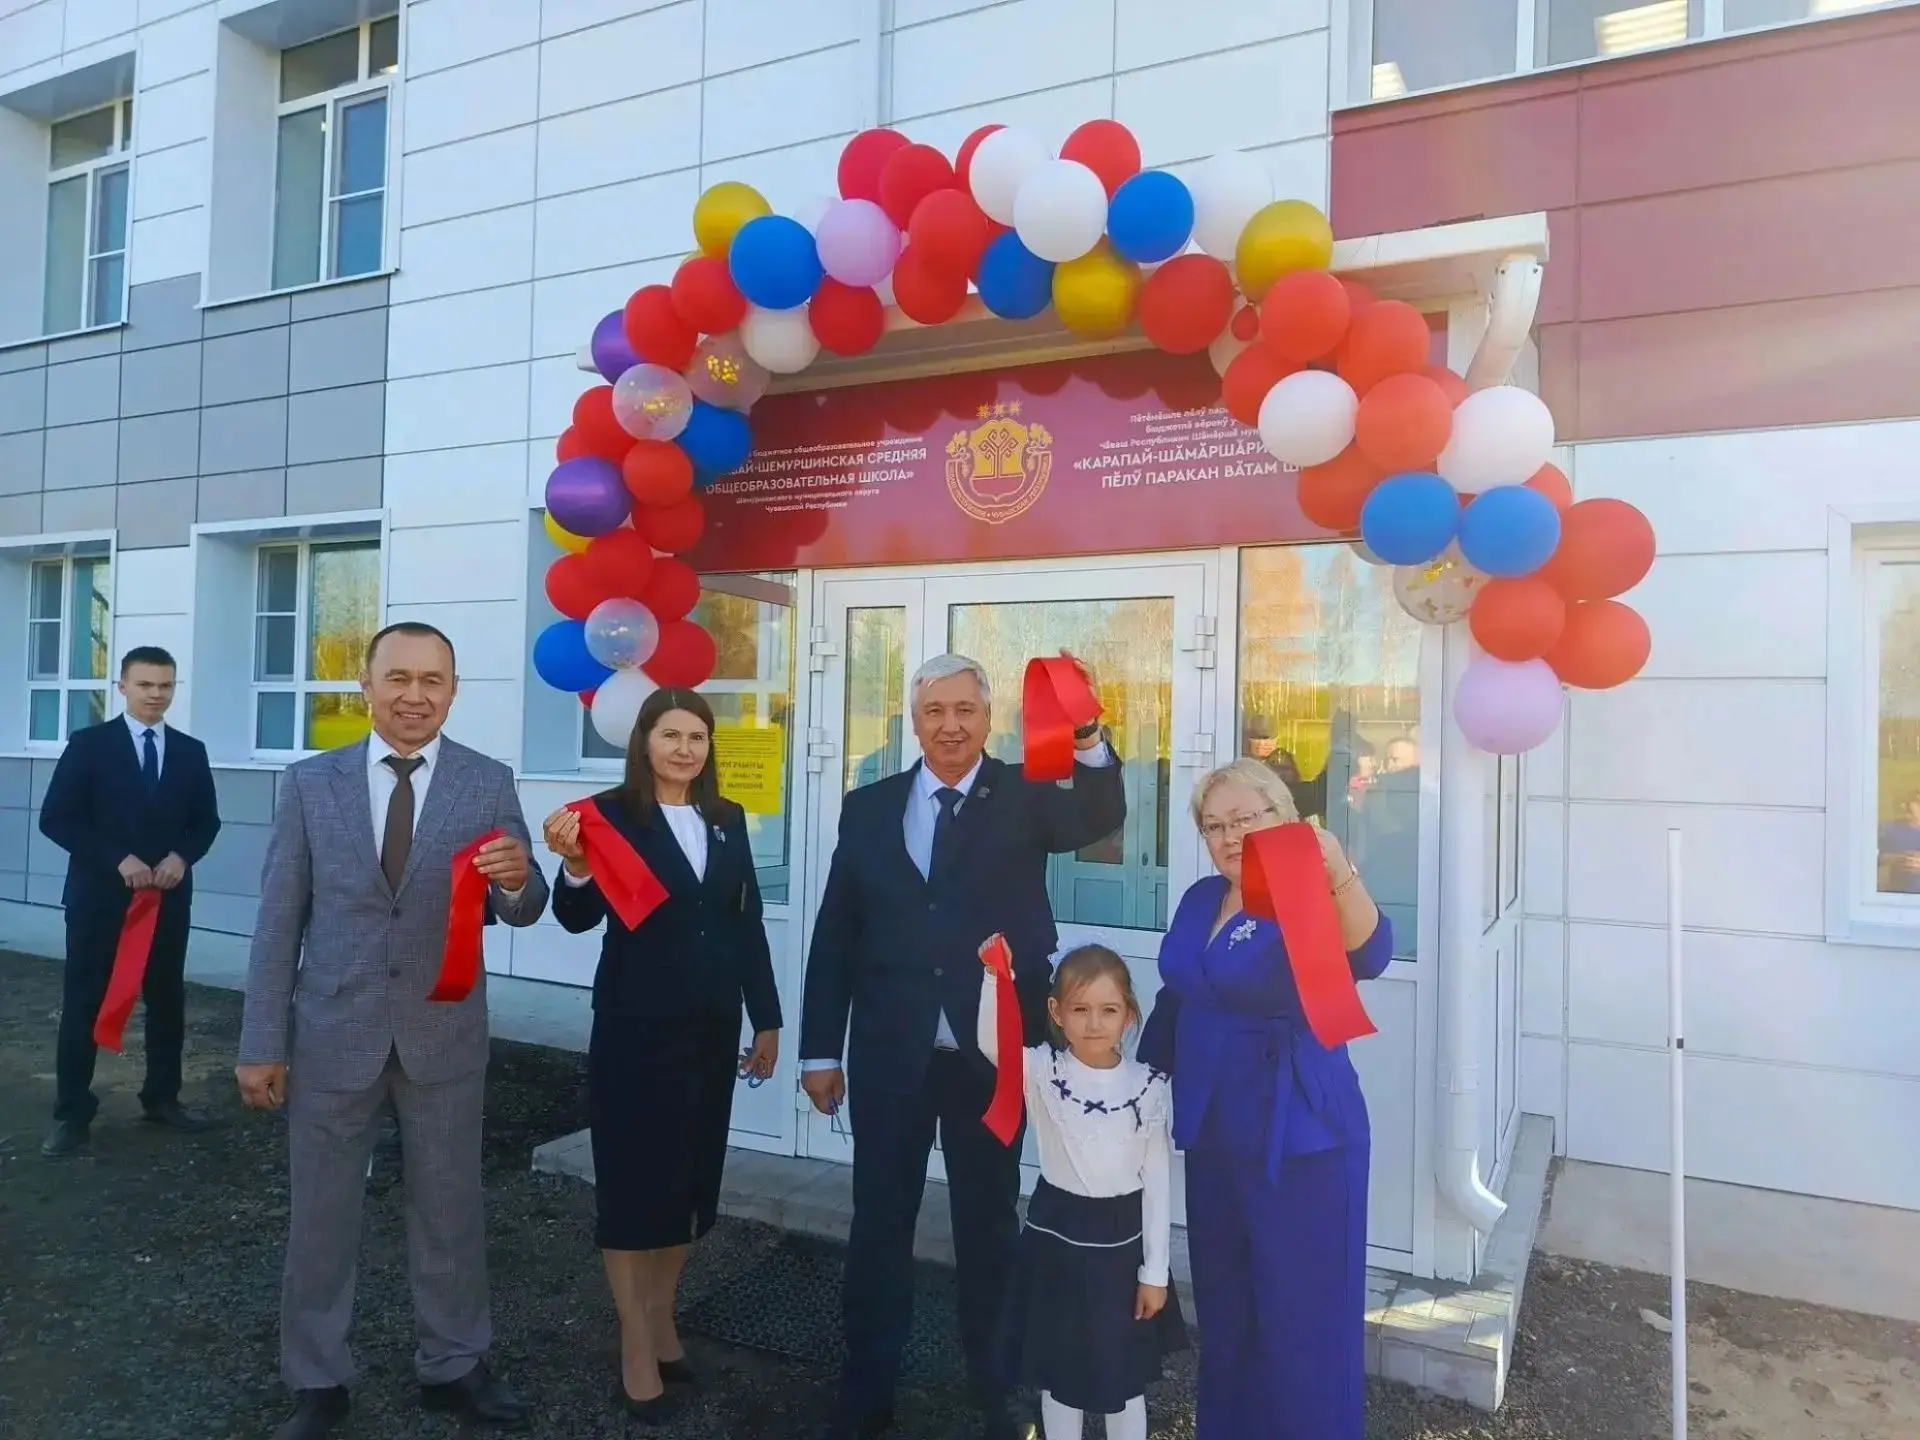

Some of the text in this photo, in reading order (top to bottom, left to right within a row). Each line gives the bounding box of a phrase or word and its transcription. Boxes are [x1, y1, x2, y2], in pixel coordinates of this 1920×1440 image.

[867, 448, 927, 465] СРЕДНЯЯ
[705, 468, 915, 495] ОБЩЕОБРАЗОВАТЕЛЬНАЯ ШКОЛА»
[1145, 466, 1220, 485] ПАРАКАН
[765, 501, 848, 513] Чувашской Республики
